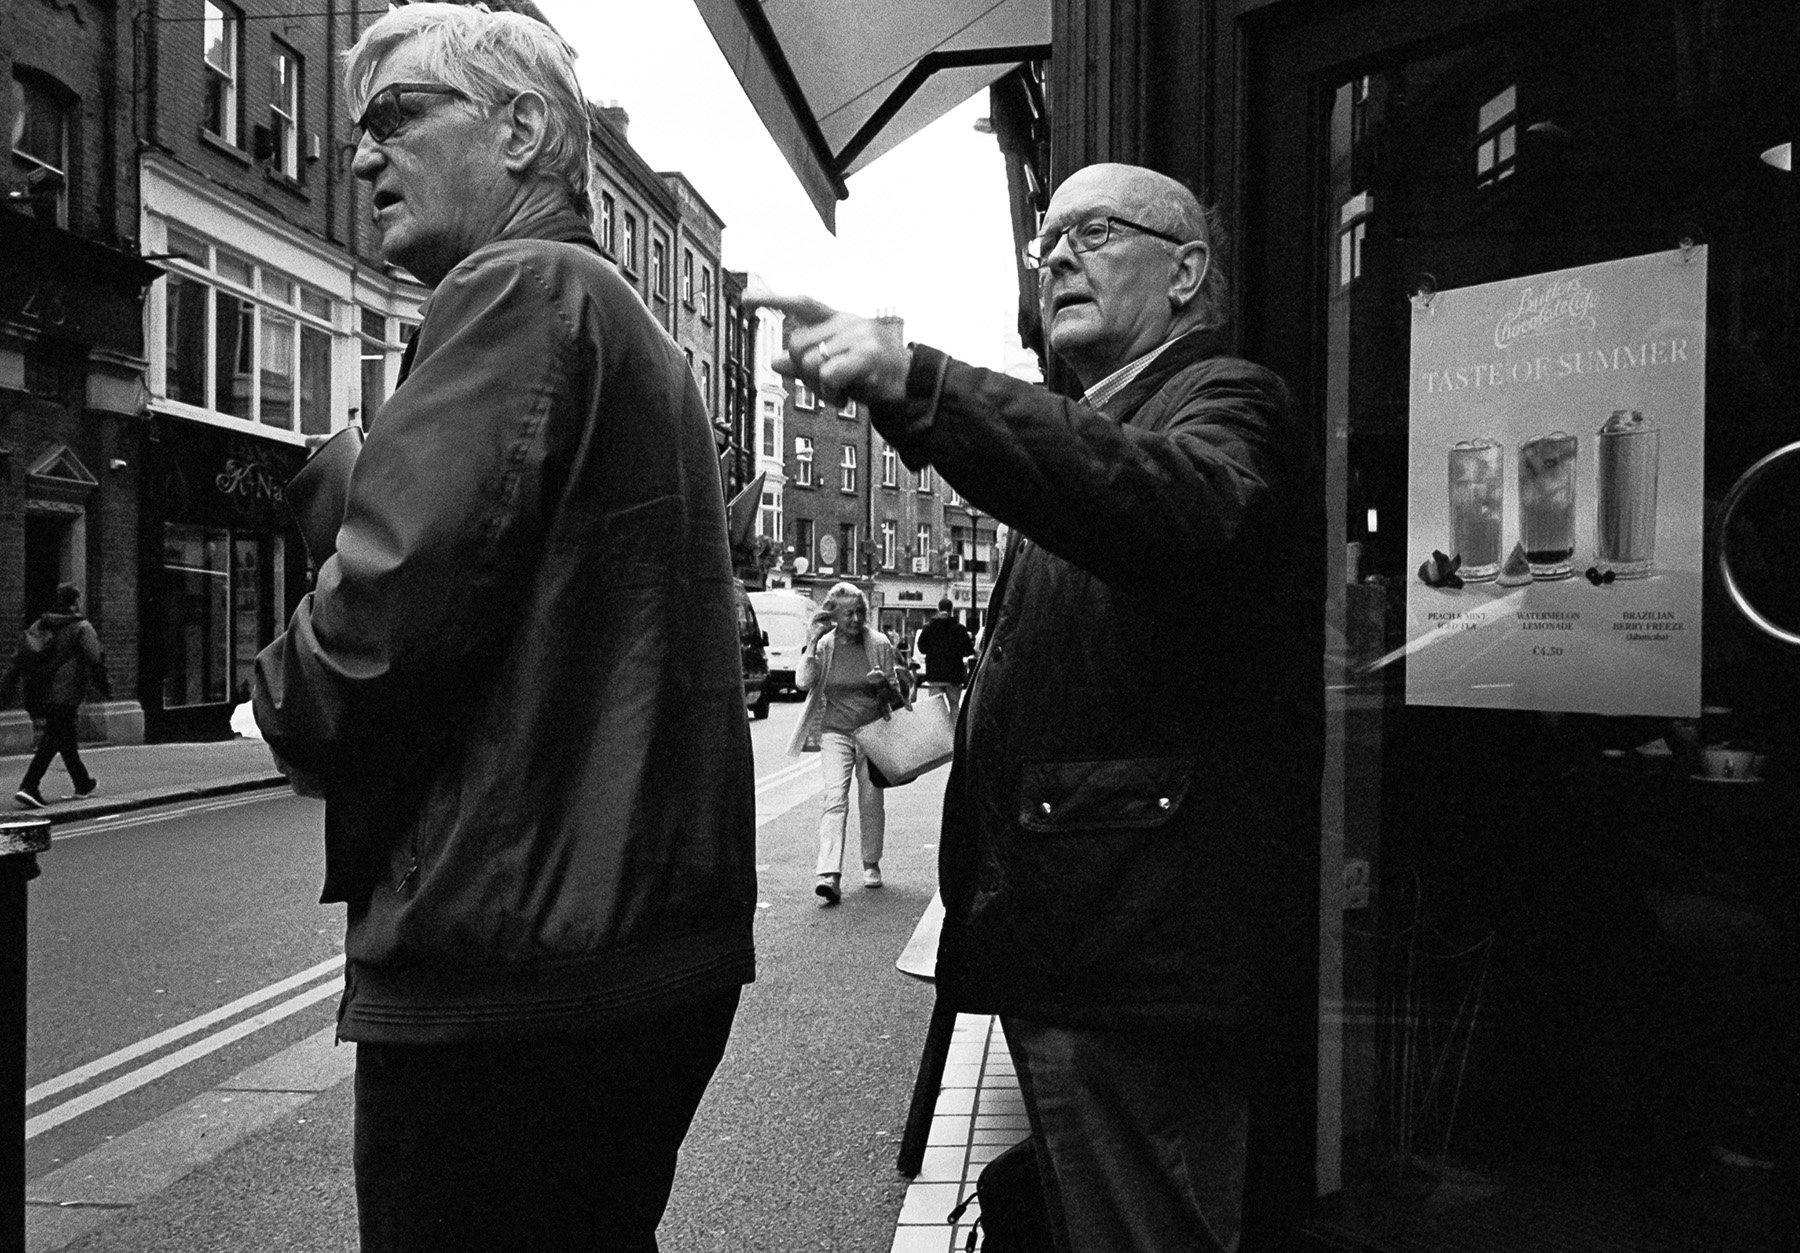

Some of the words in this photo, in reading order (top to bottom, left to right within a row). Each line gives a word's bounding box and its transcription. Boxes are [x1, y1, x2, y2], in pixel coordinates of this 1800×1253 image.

[1512, 278, 1582, 320] Butlers
[1495, 298, 1570, 348] Chocolate
[1422, 364, 1502, 393] TASTE
[1511, 356, 1550, 382] OF
[1558, 339, 1688, 376] SUMMER
[1428, 611, 1455, 620] PEACH
[1517, 611, 1580, 620] WATERMELON
[1623, 611, 1675, 620] BRAZILIAN
[1522, 621, 1574, 631] LEMONADE
[1612, 622, 1643, 631] BERRY
[1646, 622, 1686, 631] FREEZE
[1532, 645, 1563, 656] €4.50
